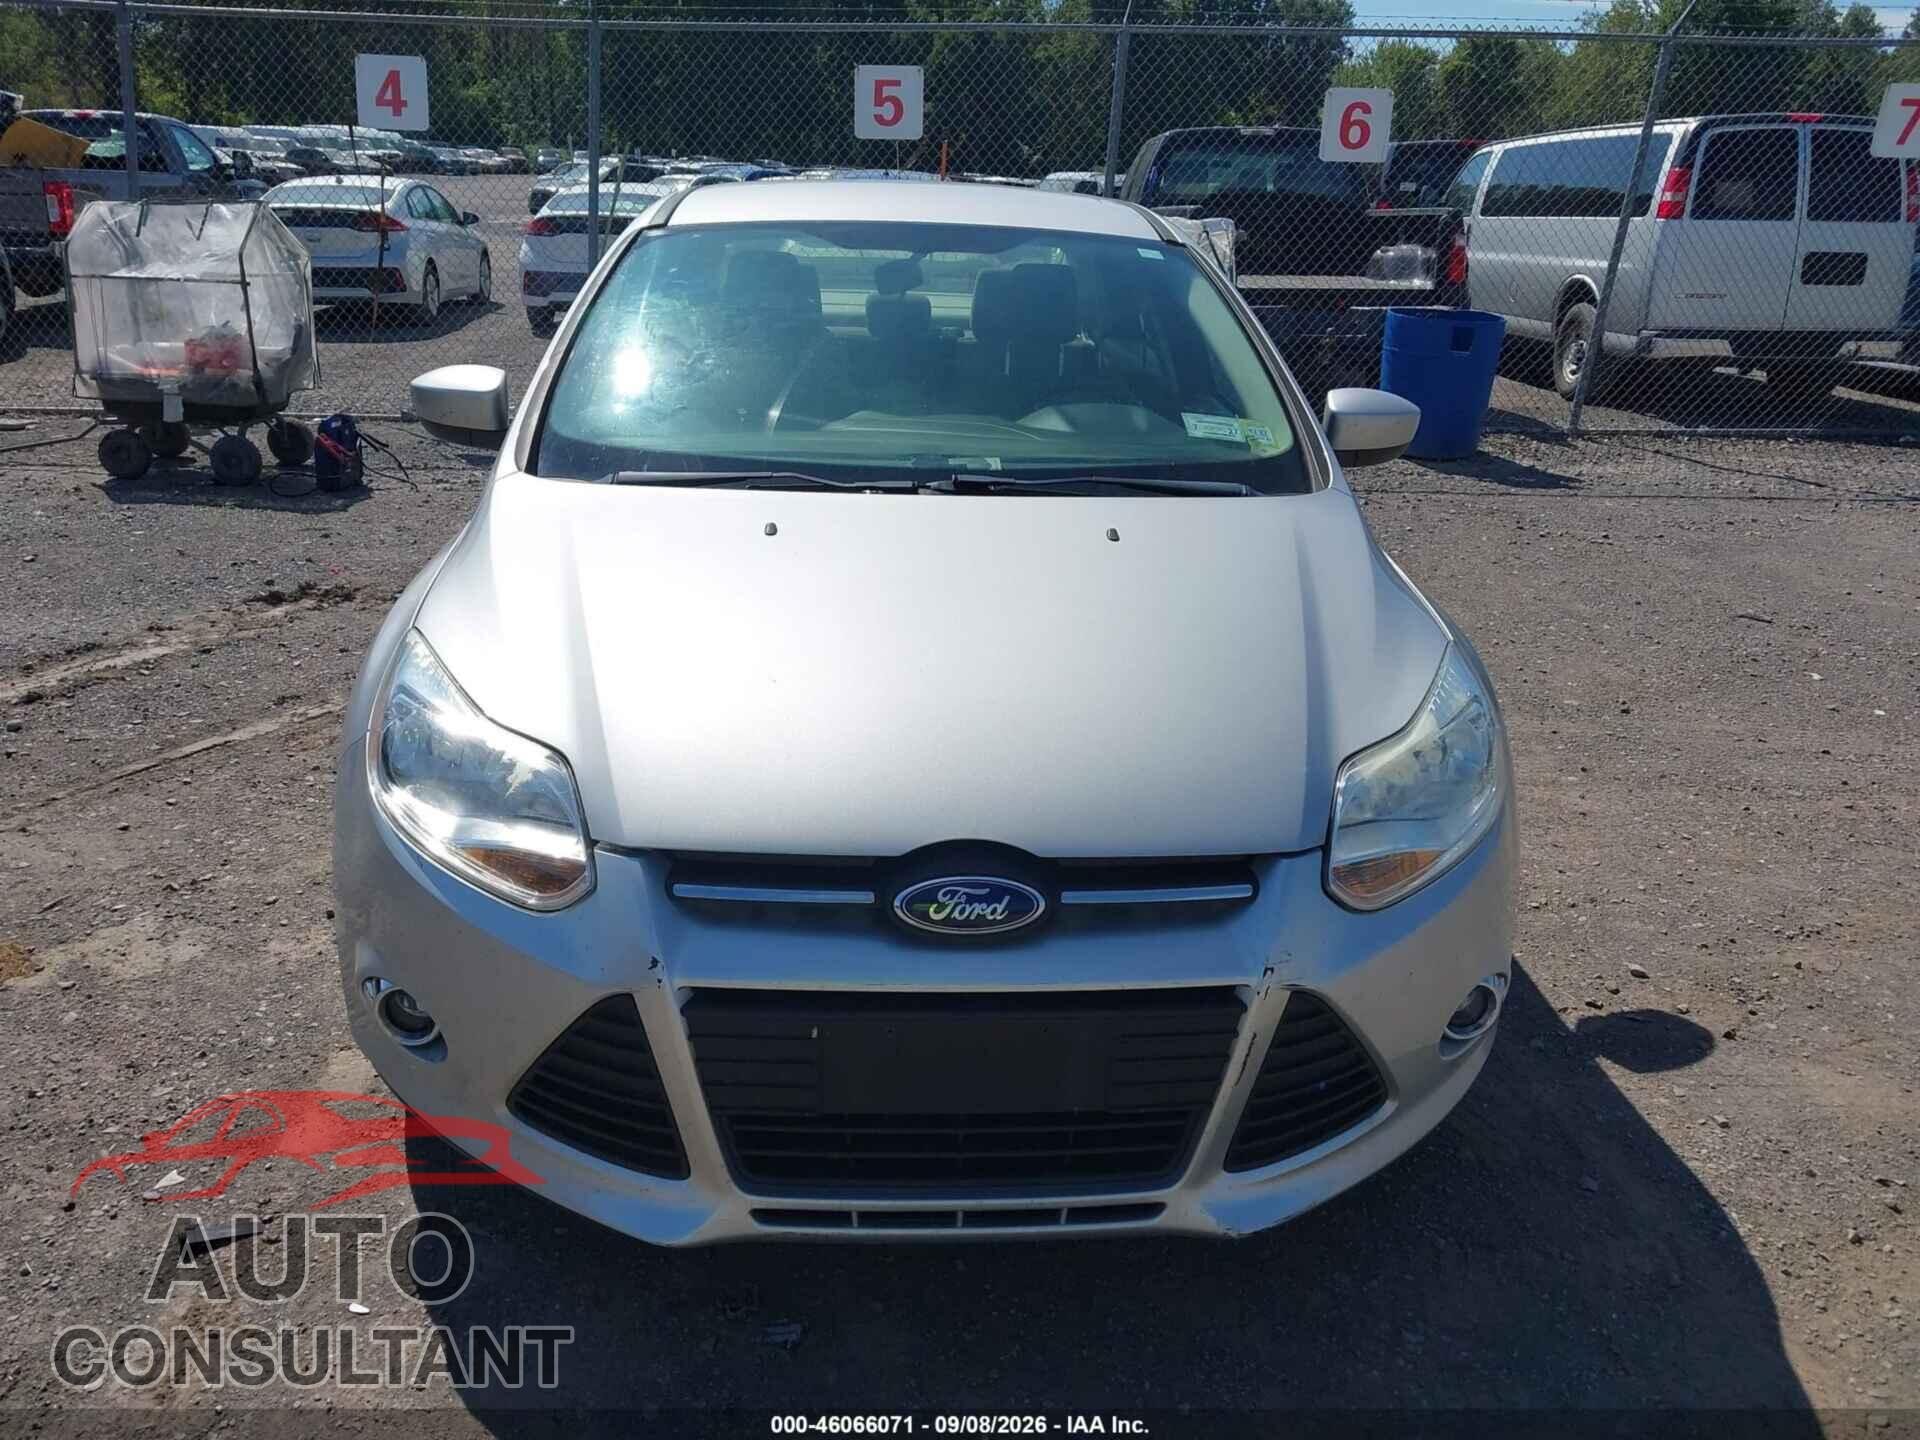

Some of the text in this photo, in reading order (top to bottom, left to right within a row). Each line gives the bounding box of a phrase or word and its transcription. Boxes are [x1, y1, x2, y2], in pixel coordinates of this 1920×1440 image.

[375, 69, 408, 117] 4
[873, 79, 904, 127] 5
[1339, 101, 1372, 150] 6
[1896, 98, 1920, 145] 7
[928, 886, 1010, 921] Ford
